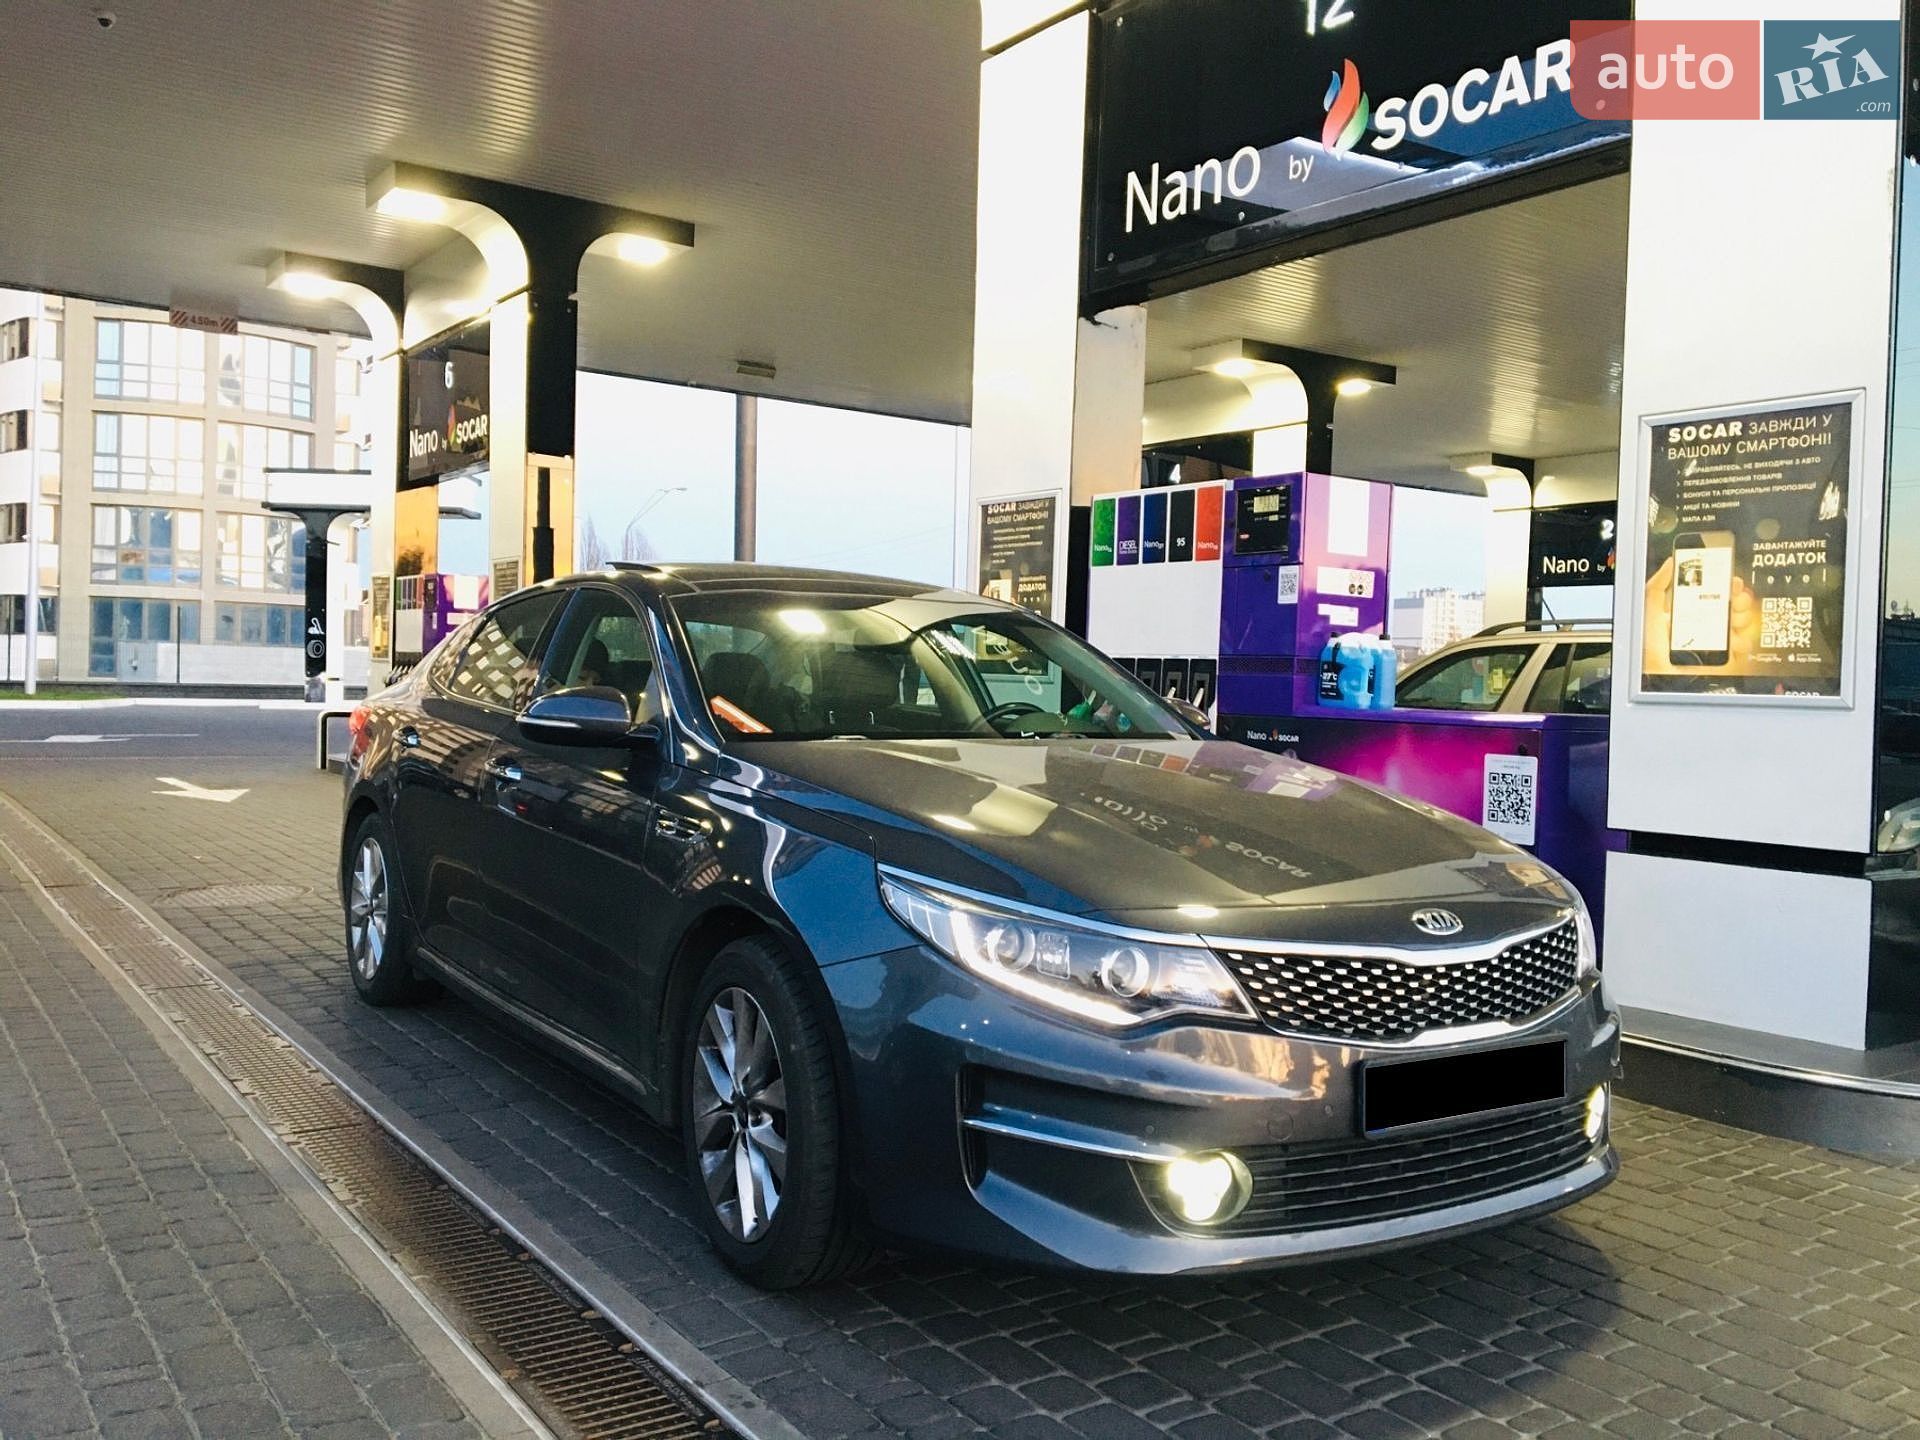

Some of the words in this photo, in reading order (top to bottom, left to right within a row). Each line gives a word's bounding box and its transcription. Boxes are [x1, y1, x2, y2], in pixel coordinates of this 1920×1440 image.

[1125, 145, 1261, 233] Nano
[1289, 154, 1315, 183] by
[1370, 37, 1576, 151] SOCAR
[444, 361, 454, 389] 6
[409, 428, 438, 458] Nano
[456, 414, 488, 444] SOCAR
[1668, 421, 1743, 443] SOCAR
[1749, 415, 1817, 435] ЗАВЖДИ
[1822, 413, 1833, 427] У
[1668, 442, 1731, 460] ВАШОМУ
[988, 502, 1016, 514] SOCAR
[1176, 536, 1186, 547] 95
[1753, 539, 1826, 551] ЗАВАНТАЖУЙТЕ
[1543, 555, 1590, 574] Nano
[1752, 551, 1827, 567] ДОДАТОК
[1425, 911, 1461, 930] KIA
